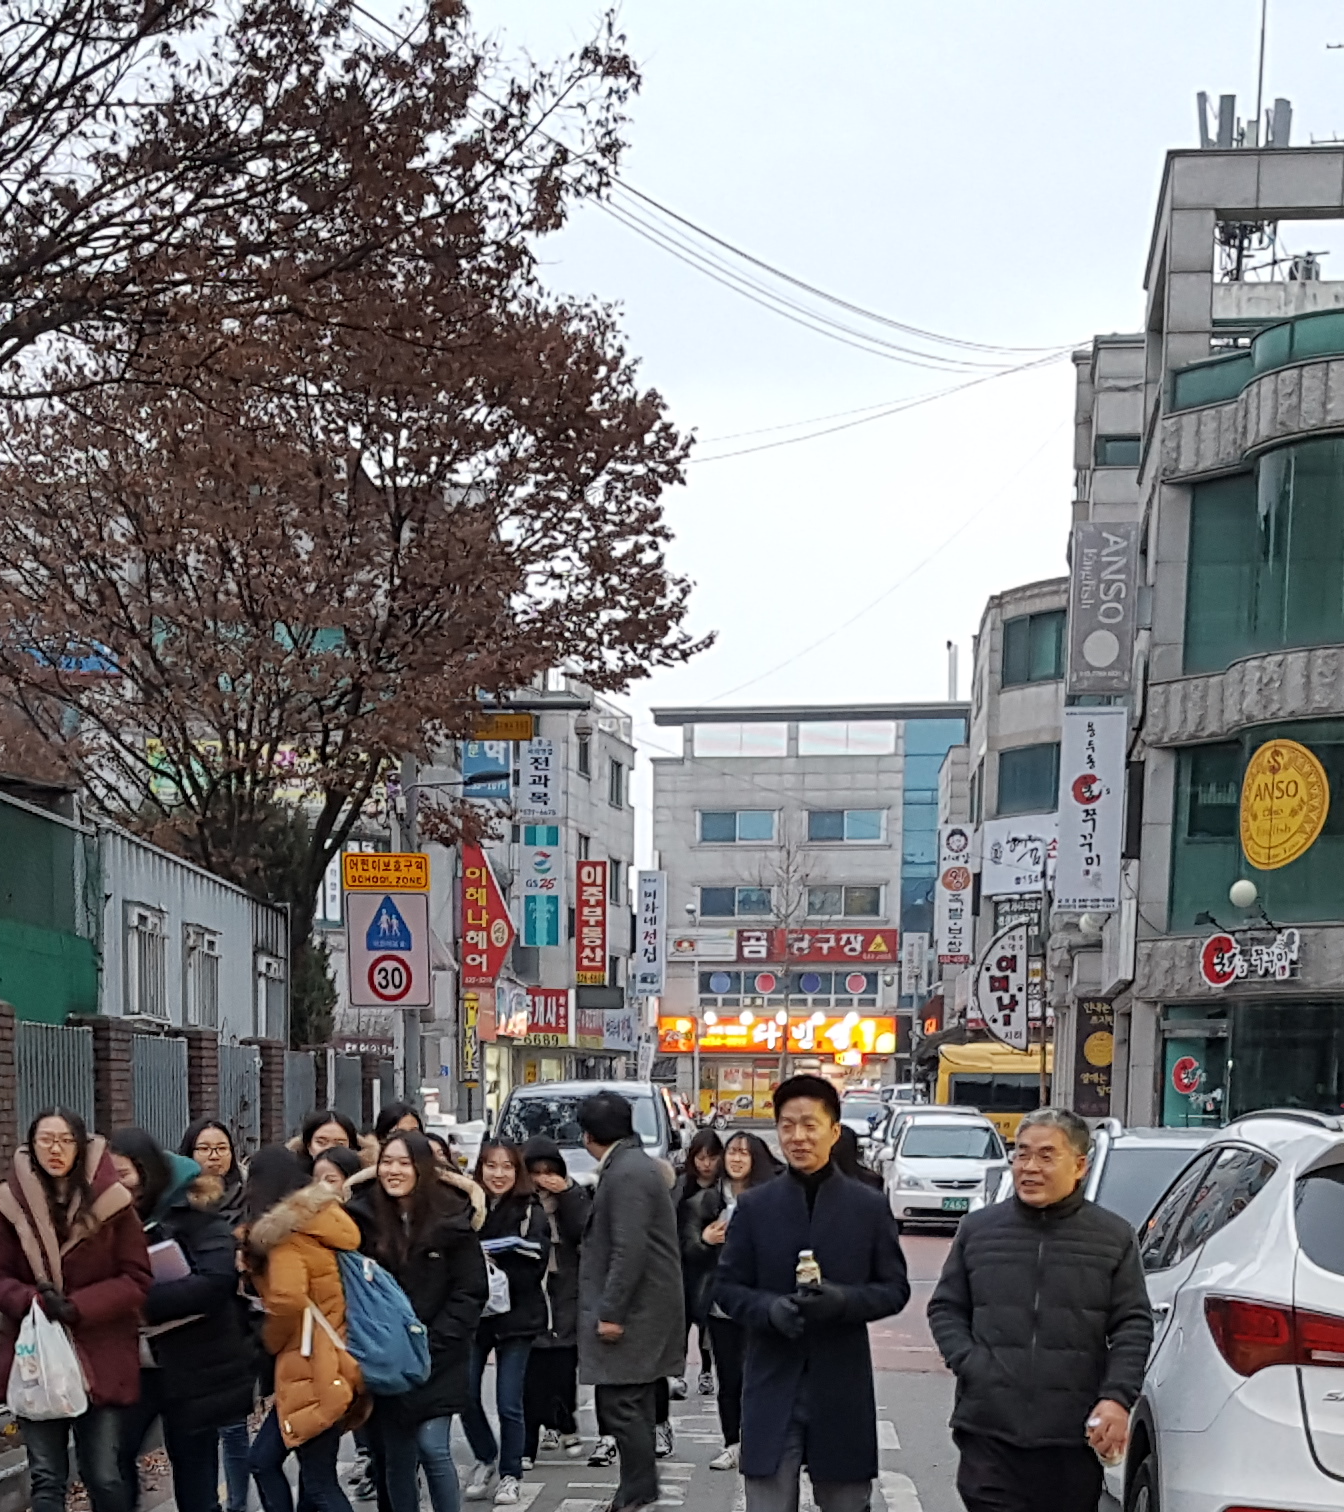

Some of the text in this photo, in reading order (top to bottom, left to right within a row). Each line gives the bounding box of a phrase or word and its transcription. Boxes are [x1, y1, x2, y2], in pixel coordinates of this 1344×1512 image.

[1098, 531, 1128, 624] ANSO
[1253, 779, 1299, 803] ANSO
[349, 858, 423, 872] 어린이보호구역
[396, 876, 422, 885] ZONE
[580, 866, 604, 966] 이주부동산
[377, 966, 403, 990] 30
